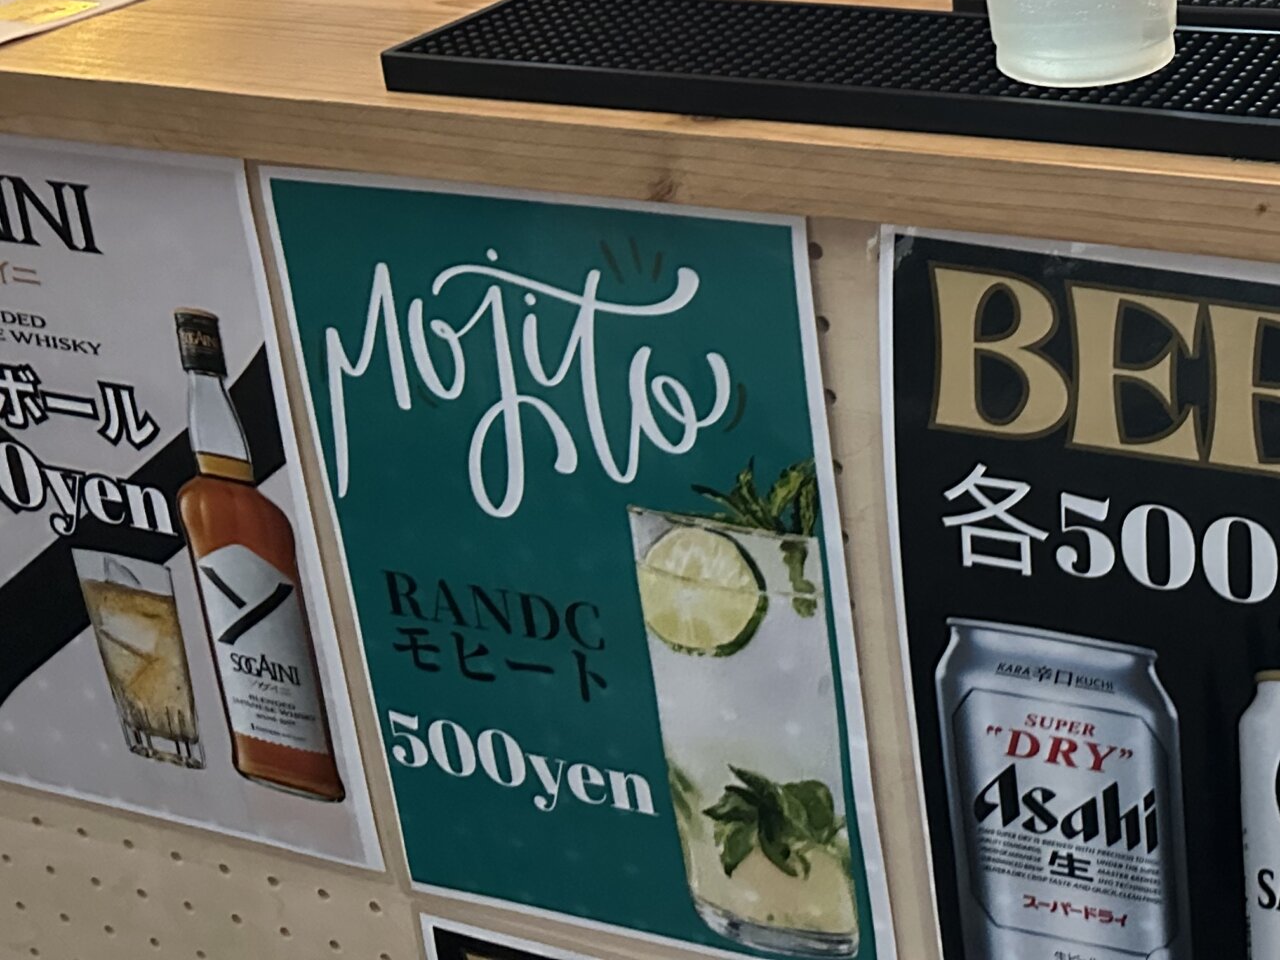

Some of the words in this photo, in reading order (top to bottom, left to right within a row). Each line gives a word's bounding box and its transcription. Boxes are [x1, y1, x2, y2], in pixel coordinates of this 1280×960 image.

[9, 330, 102, 356] WHISKY
[393, 627, 608, 703] モヒート
[995, 662, 1032, 679] KARA
[1074, 674, 1114, 692] KUCHI
[1024, 712, 1096, 737] SUPER
[388, 709, 659, 817] 500yen
[973, 762, 1159, 855] Asahi
[1048, 850, 1095, 883] 生
